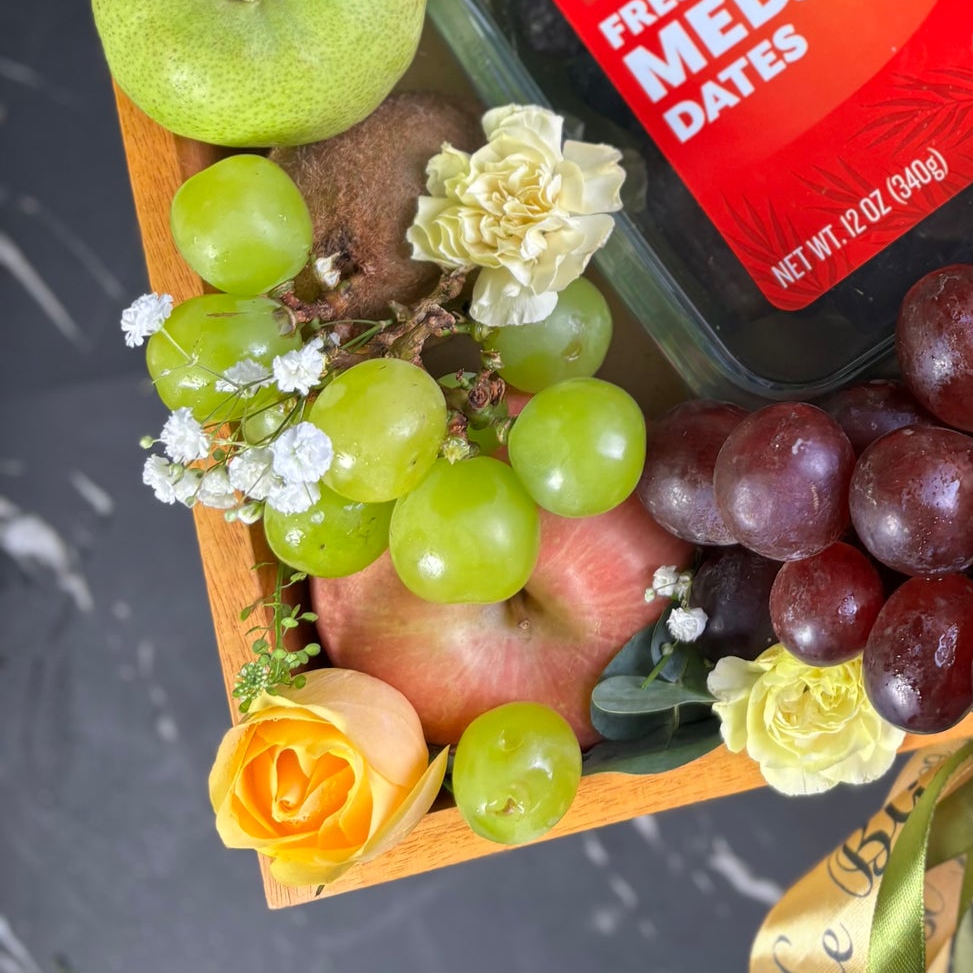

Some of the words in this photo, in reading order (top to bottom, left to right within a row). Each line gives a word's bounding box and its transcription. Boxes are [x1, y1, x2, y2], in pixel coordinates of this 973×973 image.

[662, 23, 809, 144] DATES
[770, 246, 813, 289] NET
[806, 224, 848, 262] WT.
[840, 208, 867, 238] 12
[859, 189, 892, 222] OZ
[886, 147, 949, 205] (340g)
